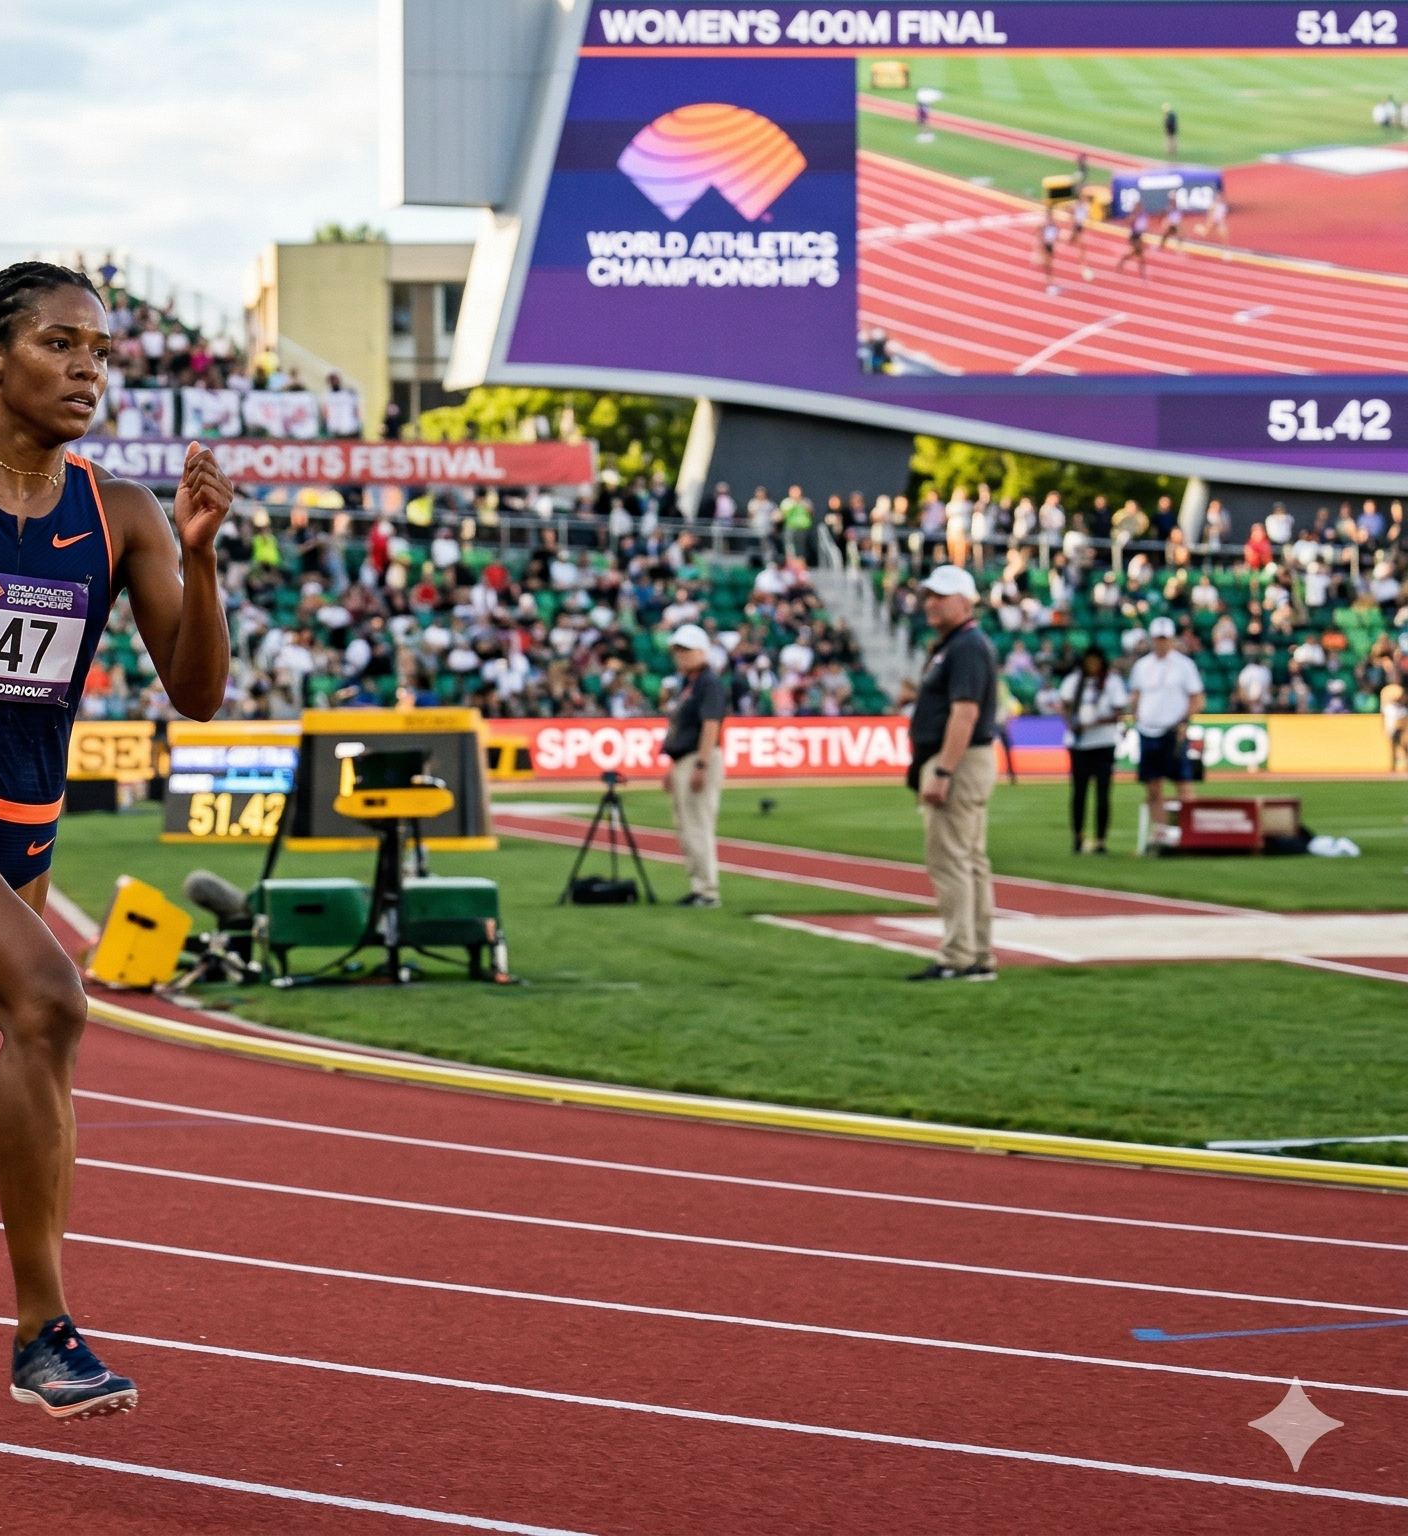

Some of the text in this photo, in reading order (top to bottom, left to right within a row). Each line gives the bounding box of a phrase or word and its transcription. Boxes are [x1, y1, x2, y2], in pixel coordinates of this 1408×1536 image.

[599, 9, 1008, 45] WOMEN'S 400M FINAL
[1295, 9, 1398, 45] 51.42
[586, 230, 840, 258] WORLD ATHLETICS
[586, 256, 841, 288] CHAMPIONSHIPS
[1267, 398, 1393, 442] 51.42
[350, 443, 505, 480] FESTIVAL
[536, 726, 913, 770] SPOR FESTIVAL
[187, 792, 287, 837] 51.42
